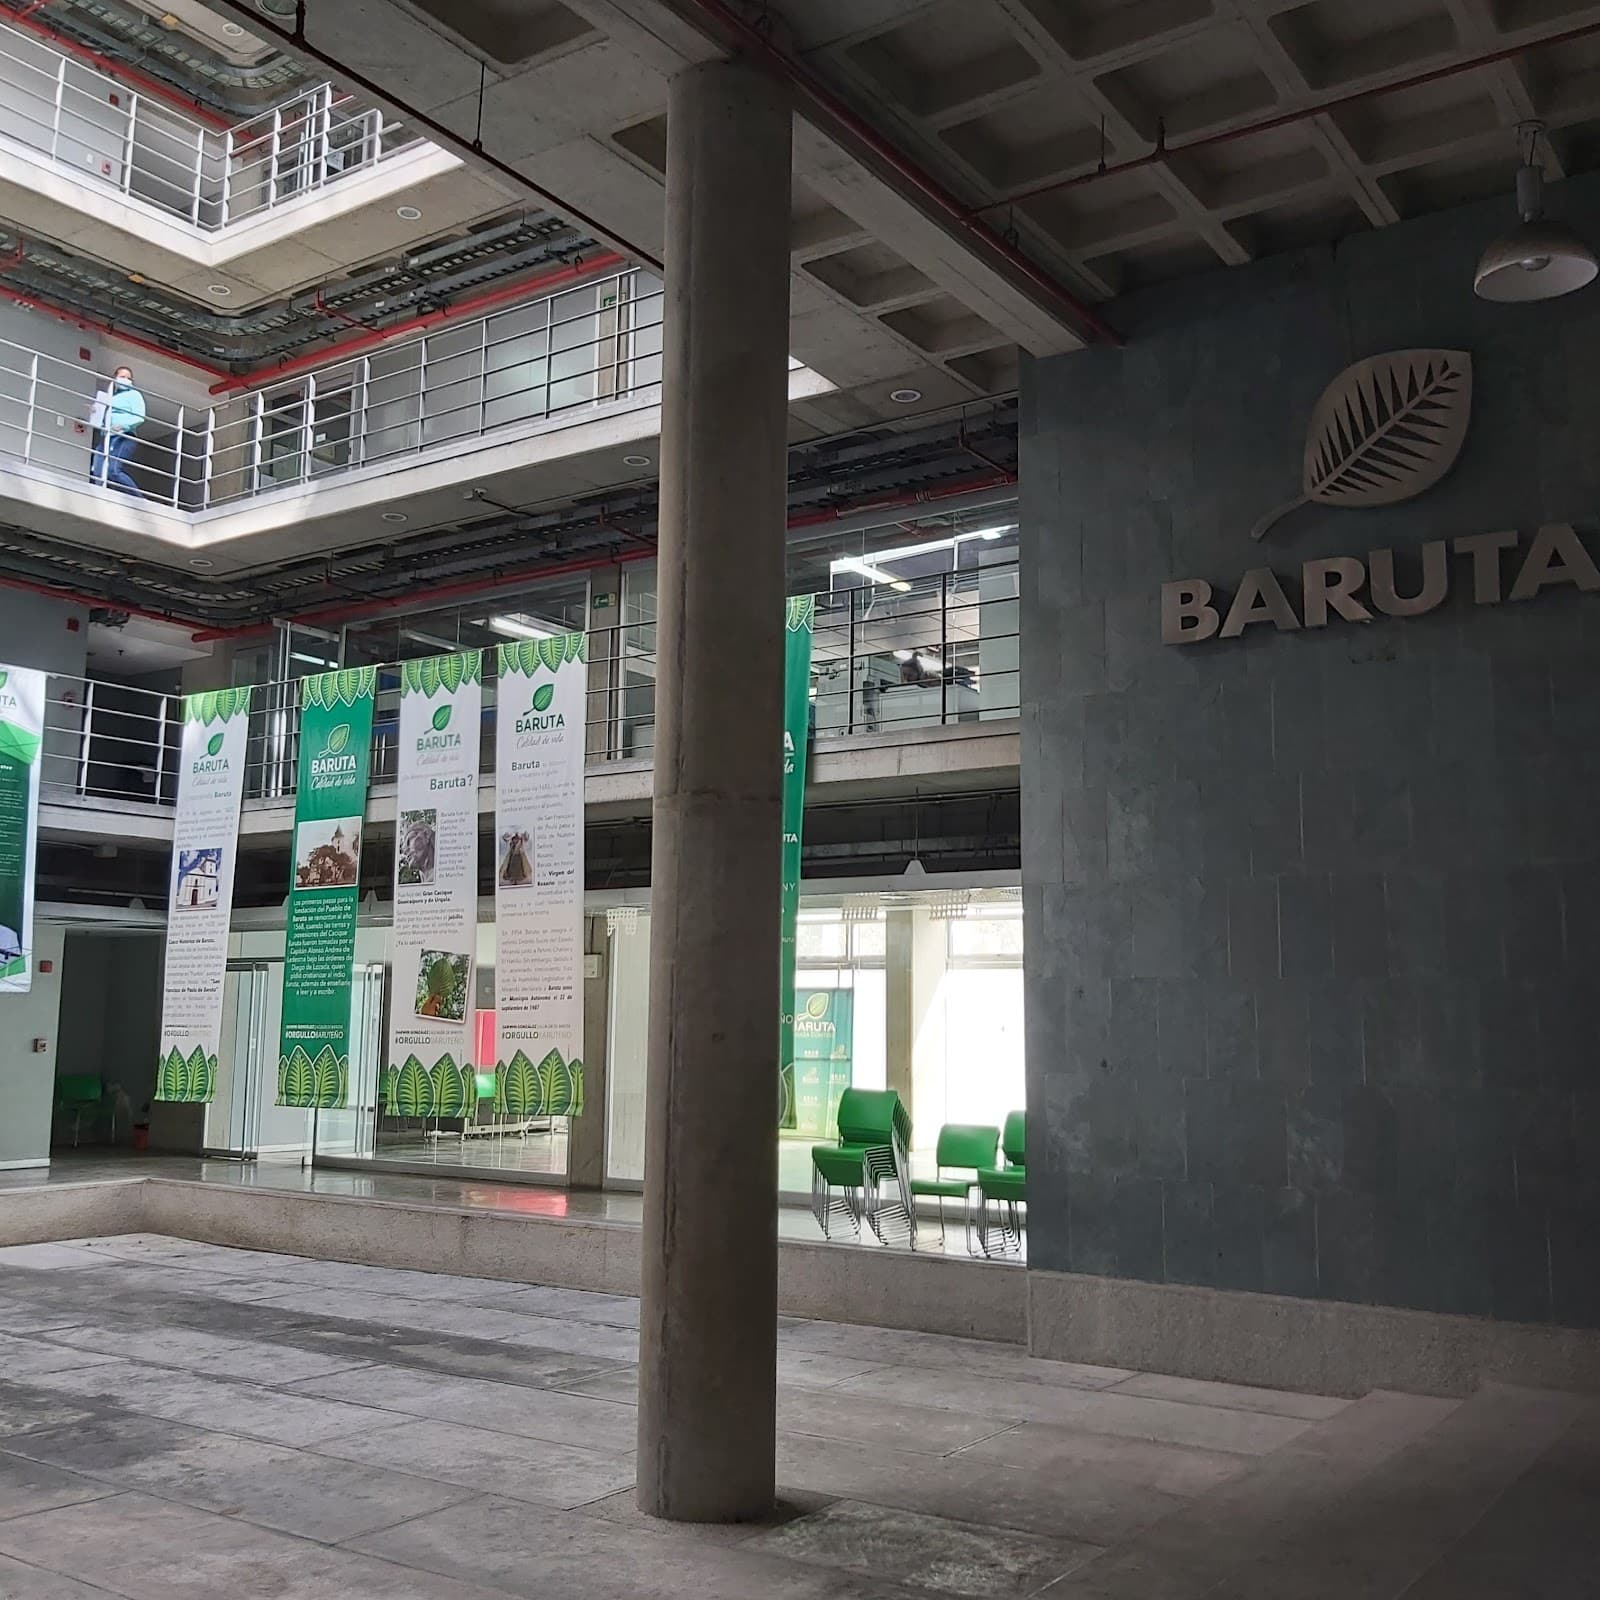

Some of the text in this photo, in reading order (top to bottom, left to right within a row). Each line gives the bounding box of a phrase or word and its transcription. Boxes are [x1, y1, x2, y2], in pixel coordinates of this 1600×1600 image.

[1161, 522, 1600, 645] BARUTA
[516, 714, 565, 733] BARUTA
[416, 731, 461, 751] BARUTA
[193, 759, 229, 774] BARUTA
[312, 755, 356, 773] BARUTA
[511, 761, 540, 771] Baruta
[430, 774, 473, 790] Baruta?
